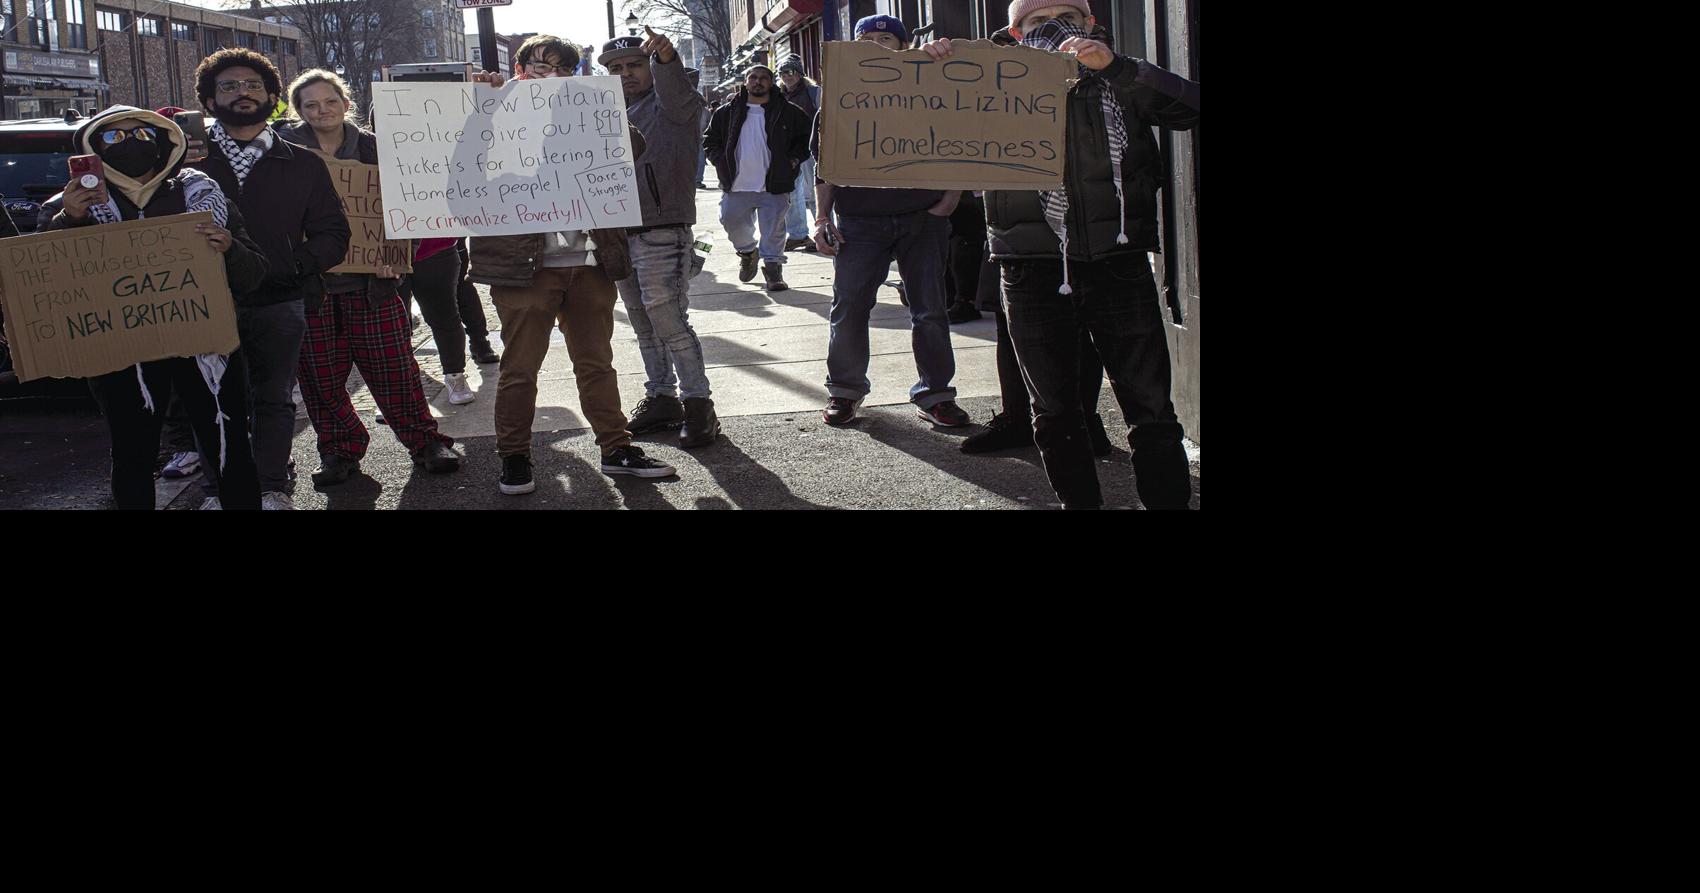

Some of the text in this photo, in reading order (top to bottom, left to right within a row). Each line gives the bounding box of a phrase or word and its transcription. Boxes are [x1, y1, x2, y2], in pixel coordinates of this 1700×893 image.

[858, 57, 1029, 90] STOP
[381, 81, 617, 117] In New Britain
[392, 108, 623, 150] police give out $99
[854, 119, 1057, 161] Homelessness
[395, 138, 626, 176] tickets for loitering to
[340, 168, 352, 193] 4
[399, 169, 561, 204] Homeless people!
[586, 171, 617, 185] Dare
[588, 183, 629, 198] Struggle
[11, 202, 32, 211] Ford
[388, 205, 510, 233] De-criminalize
[603, 199, 628, 216] CT
[9, 226, 181, 268] DIGNITY FOR
[16, 267, 51, 287] THE
[33, 268, 199, 313] FROM GAZA
[66, 308, 114, 340] NEW
[121, 294, 210, 329] BRITAIN
